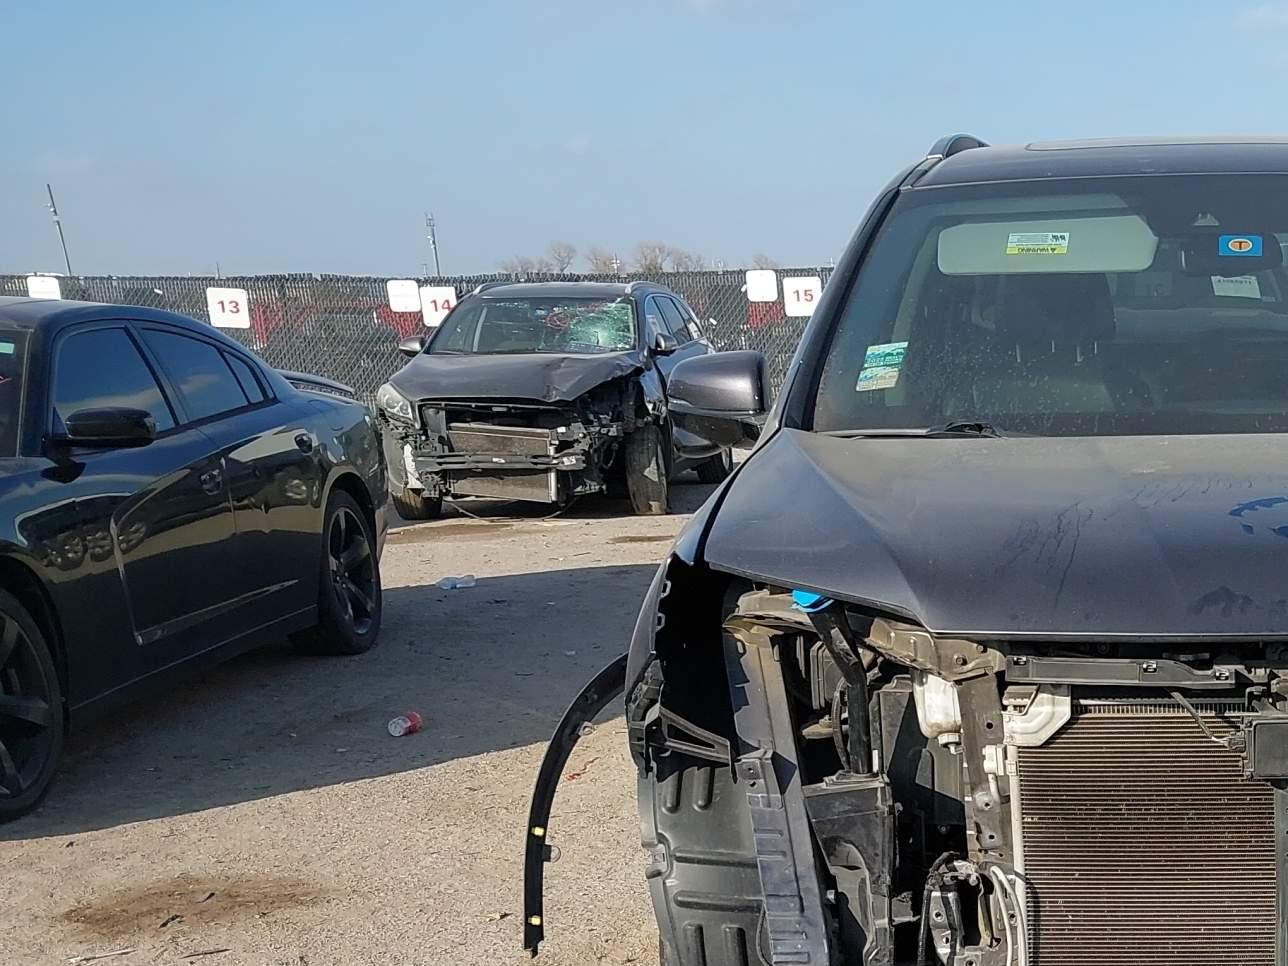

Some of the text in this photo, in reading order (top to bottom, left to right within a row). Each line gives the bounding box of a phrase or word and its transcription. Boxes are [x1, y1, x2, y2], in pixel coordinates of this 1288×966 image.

[793, 289, 814, 303] 15
[216, 300, 241, 315] 13
[429, 299, 453, 313] 14
